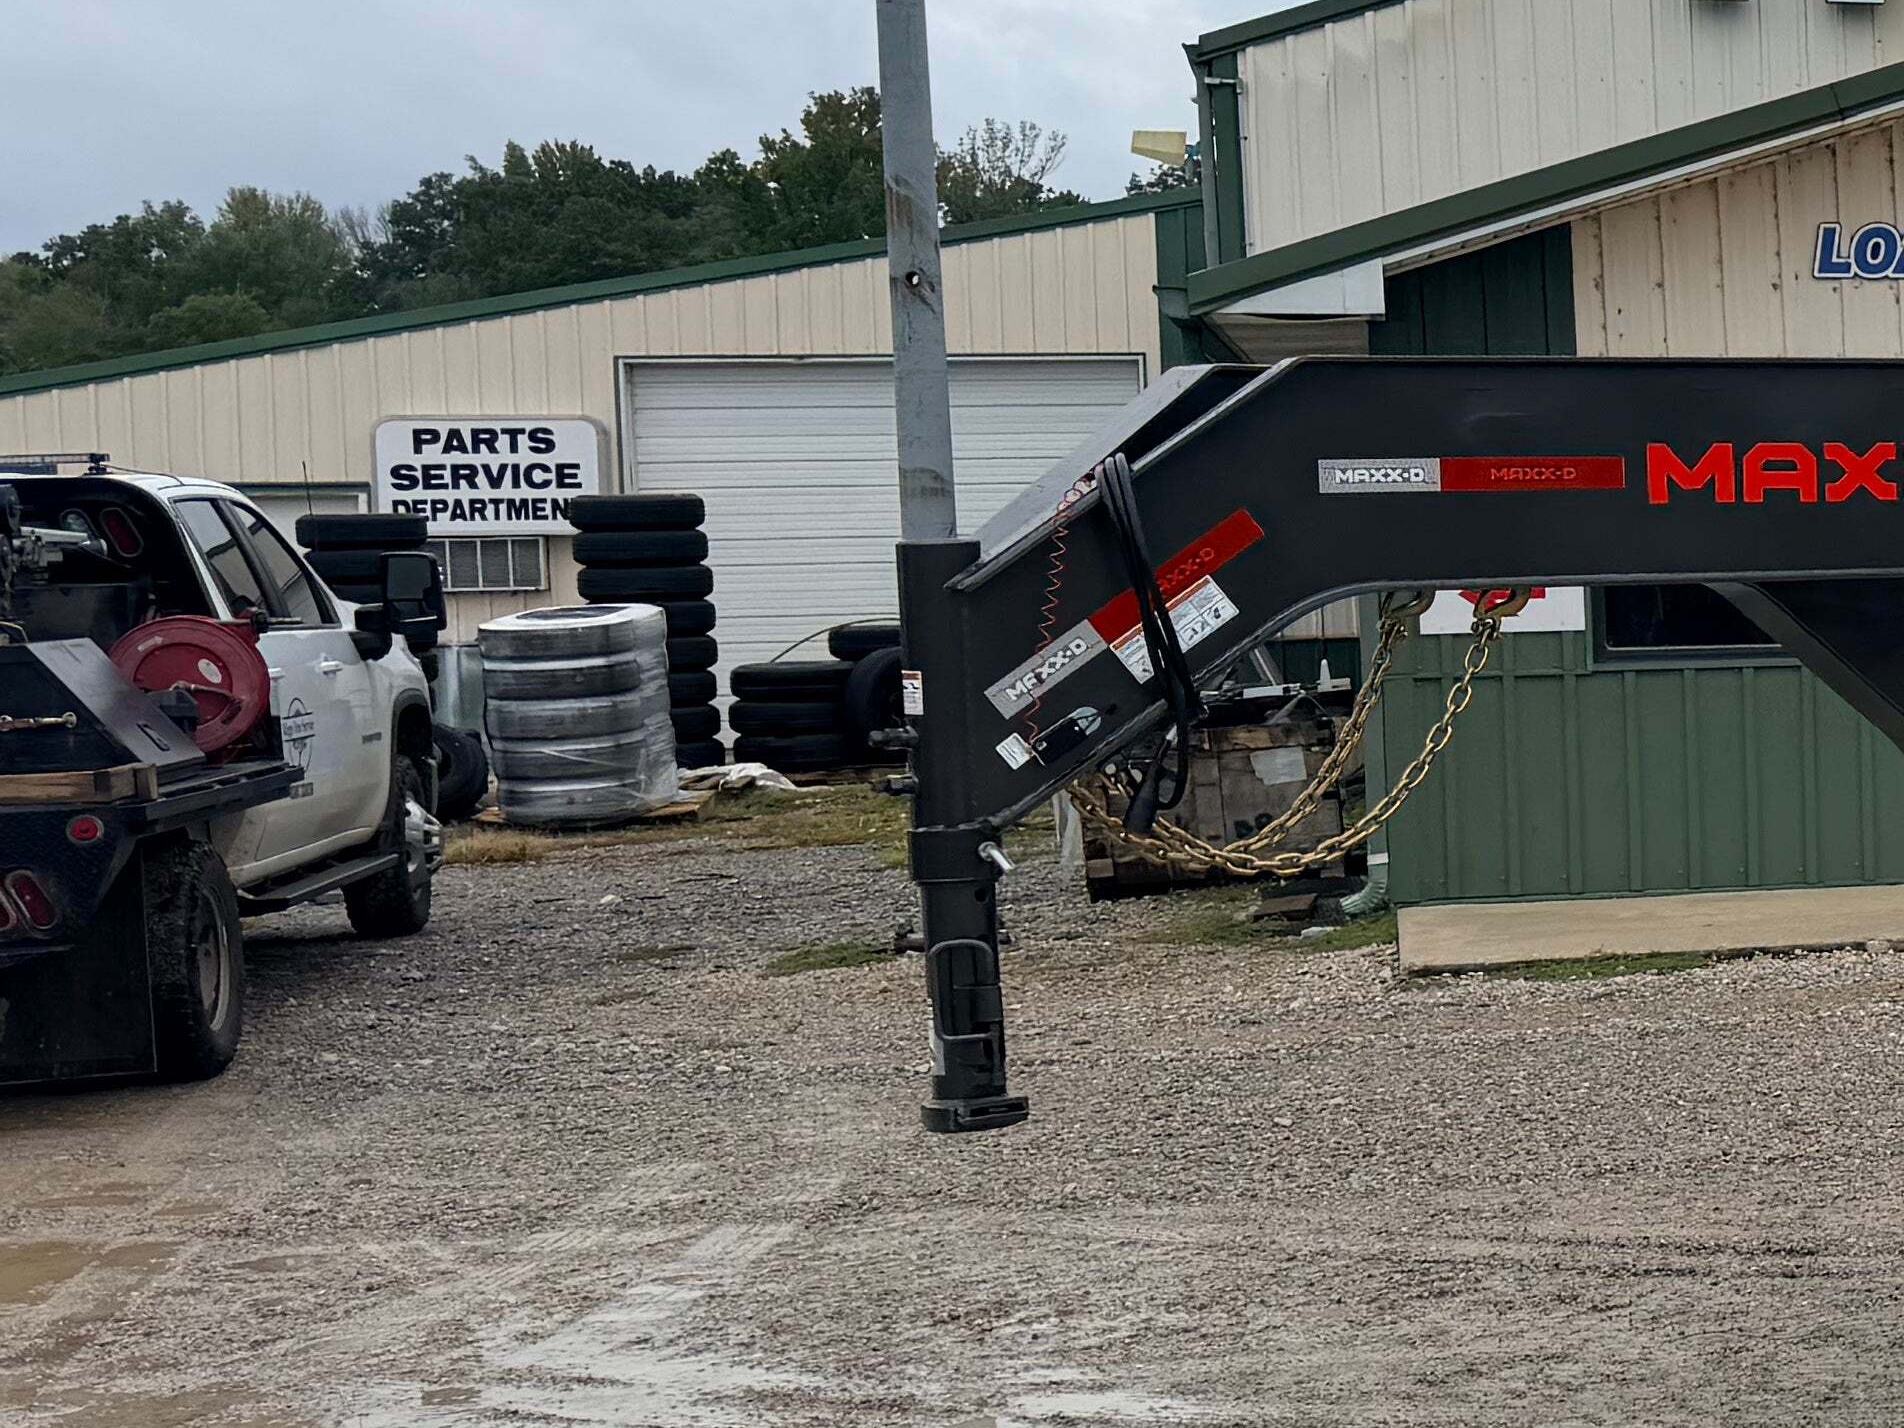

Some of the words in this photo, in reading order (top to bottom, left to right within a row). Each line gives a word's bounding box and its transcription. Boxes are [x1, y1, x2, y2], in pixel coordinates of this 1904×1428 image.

[412, 427, 556, 455] PARTS
[389, 463, 583, 491] SERVICE
[1333, 467, 1425, 486] MAXX-D
[1490, 466, 1577, 482] MAXX-D
[391, 497, 571, 522] DEPARTMEN
